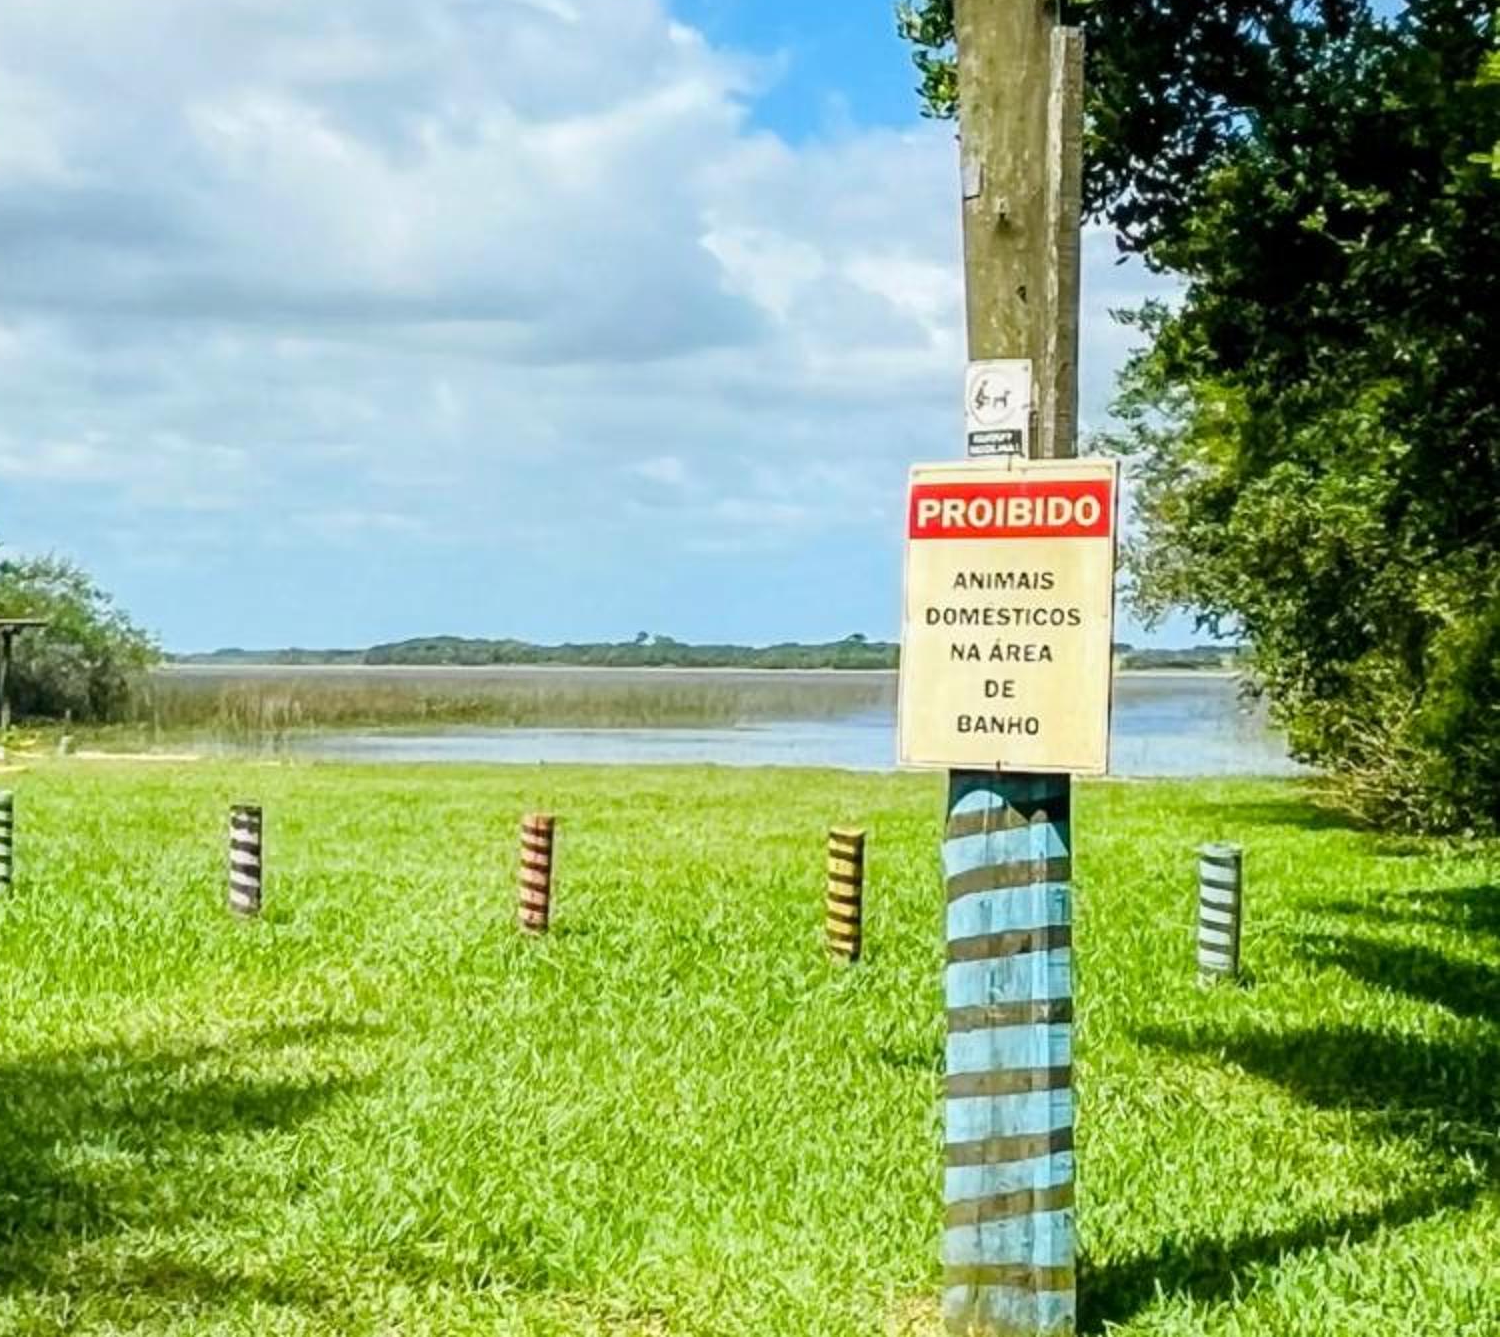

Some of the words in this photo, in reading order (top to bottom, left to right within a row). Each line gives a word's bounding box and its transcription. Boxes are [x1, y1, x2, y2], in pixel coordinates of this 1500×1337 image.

[916, 495, 1101, 528] PROIBIDO
[953, 572, 1055, 591] ANIMAIS
[950, 643, 981, 662] NA
[988, 637, 1053, 663] ÁREA
[984, 679, 1016, 699] DE
[956, 715, 1040, 736] BANHO
